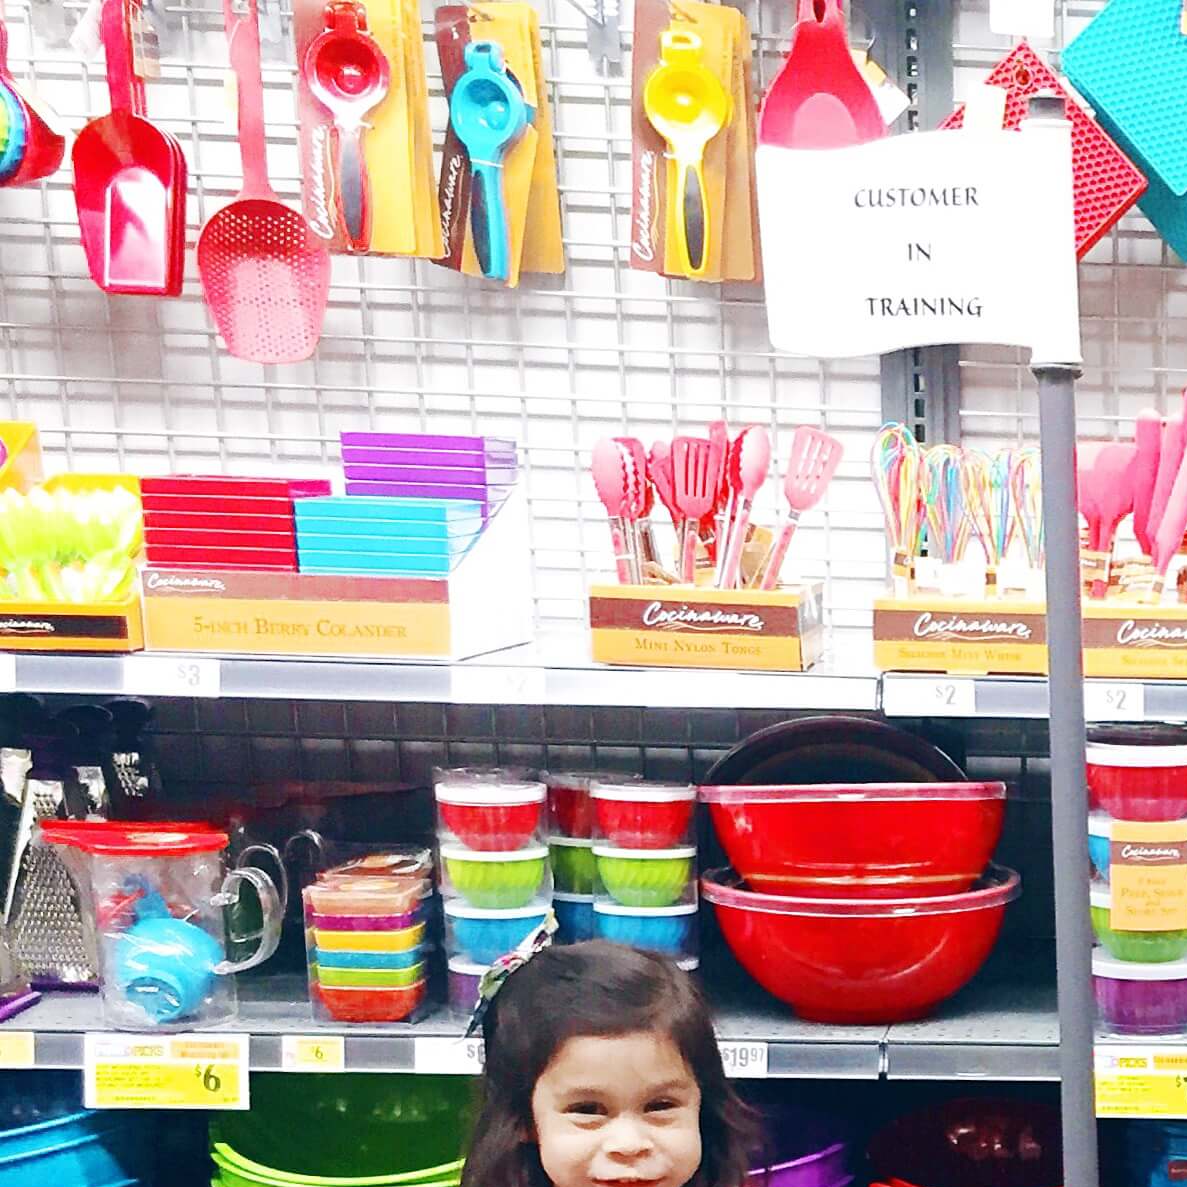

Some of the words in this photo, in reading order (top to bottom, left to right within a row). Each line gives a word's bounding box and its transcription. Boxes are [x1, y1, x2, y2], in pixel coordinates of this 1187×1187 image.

[854, 187, 979, 208] CUSTOMER
[907, 243, 932, 262] IN
[865, 297, 984, 318] TRAINING
[643, 602, 764, 630] Cocinaware
[913, 612, 1032, 639] Cocinaware
[177, 664, 200, 687] $3
[935, 685, 957, 705] $2
[1106, 690, 1127, 711] $2
[195, 1064, 221, 1093] $6
